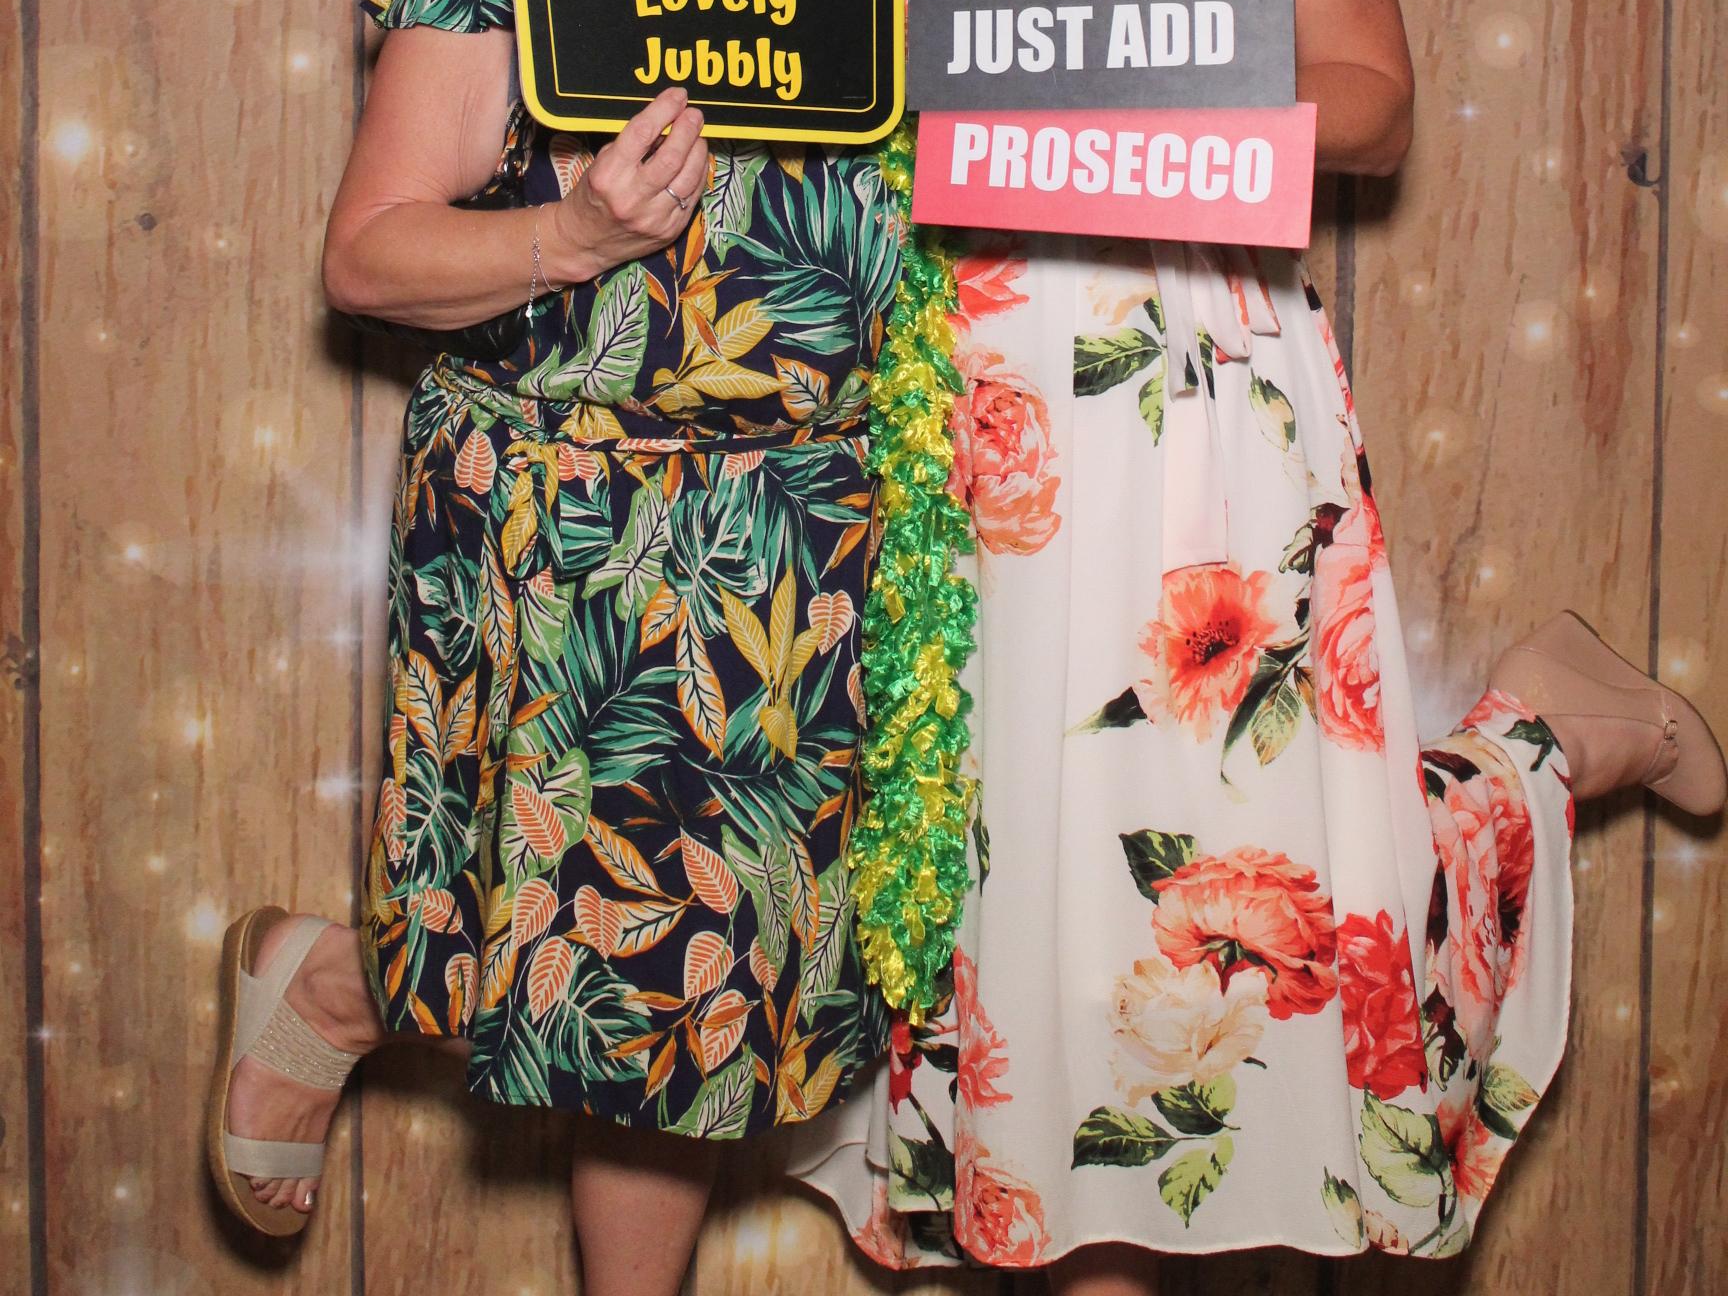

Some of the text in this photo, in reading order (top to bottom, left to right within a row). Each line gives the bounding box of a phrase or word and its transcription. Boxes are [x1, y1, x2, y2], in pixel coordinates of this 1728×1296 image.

[634, 37, 802, 101] Jubbly
[947, 1, 1235, 74] JUST ADD
[950, 123, 1275, 205] PROSECCO
